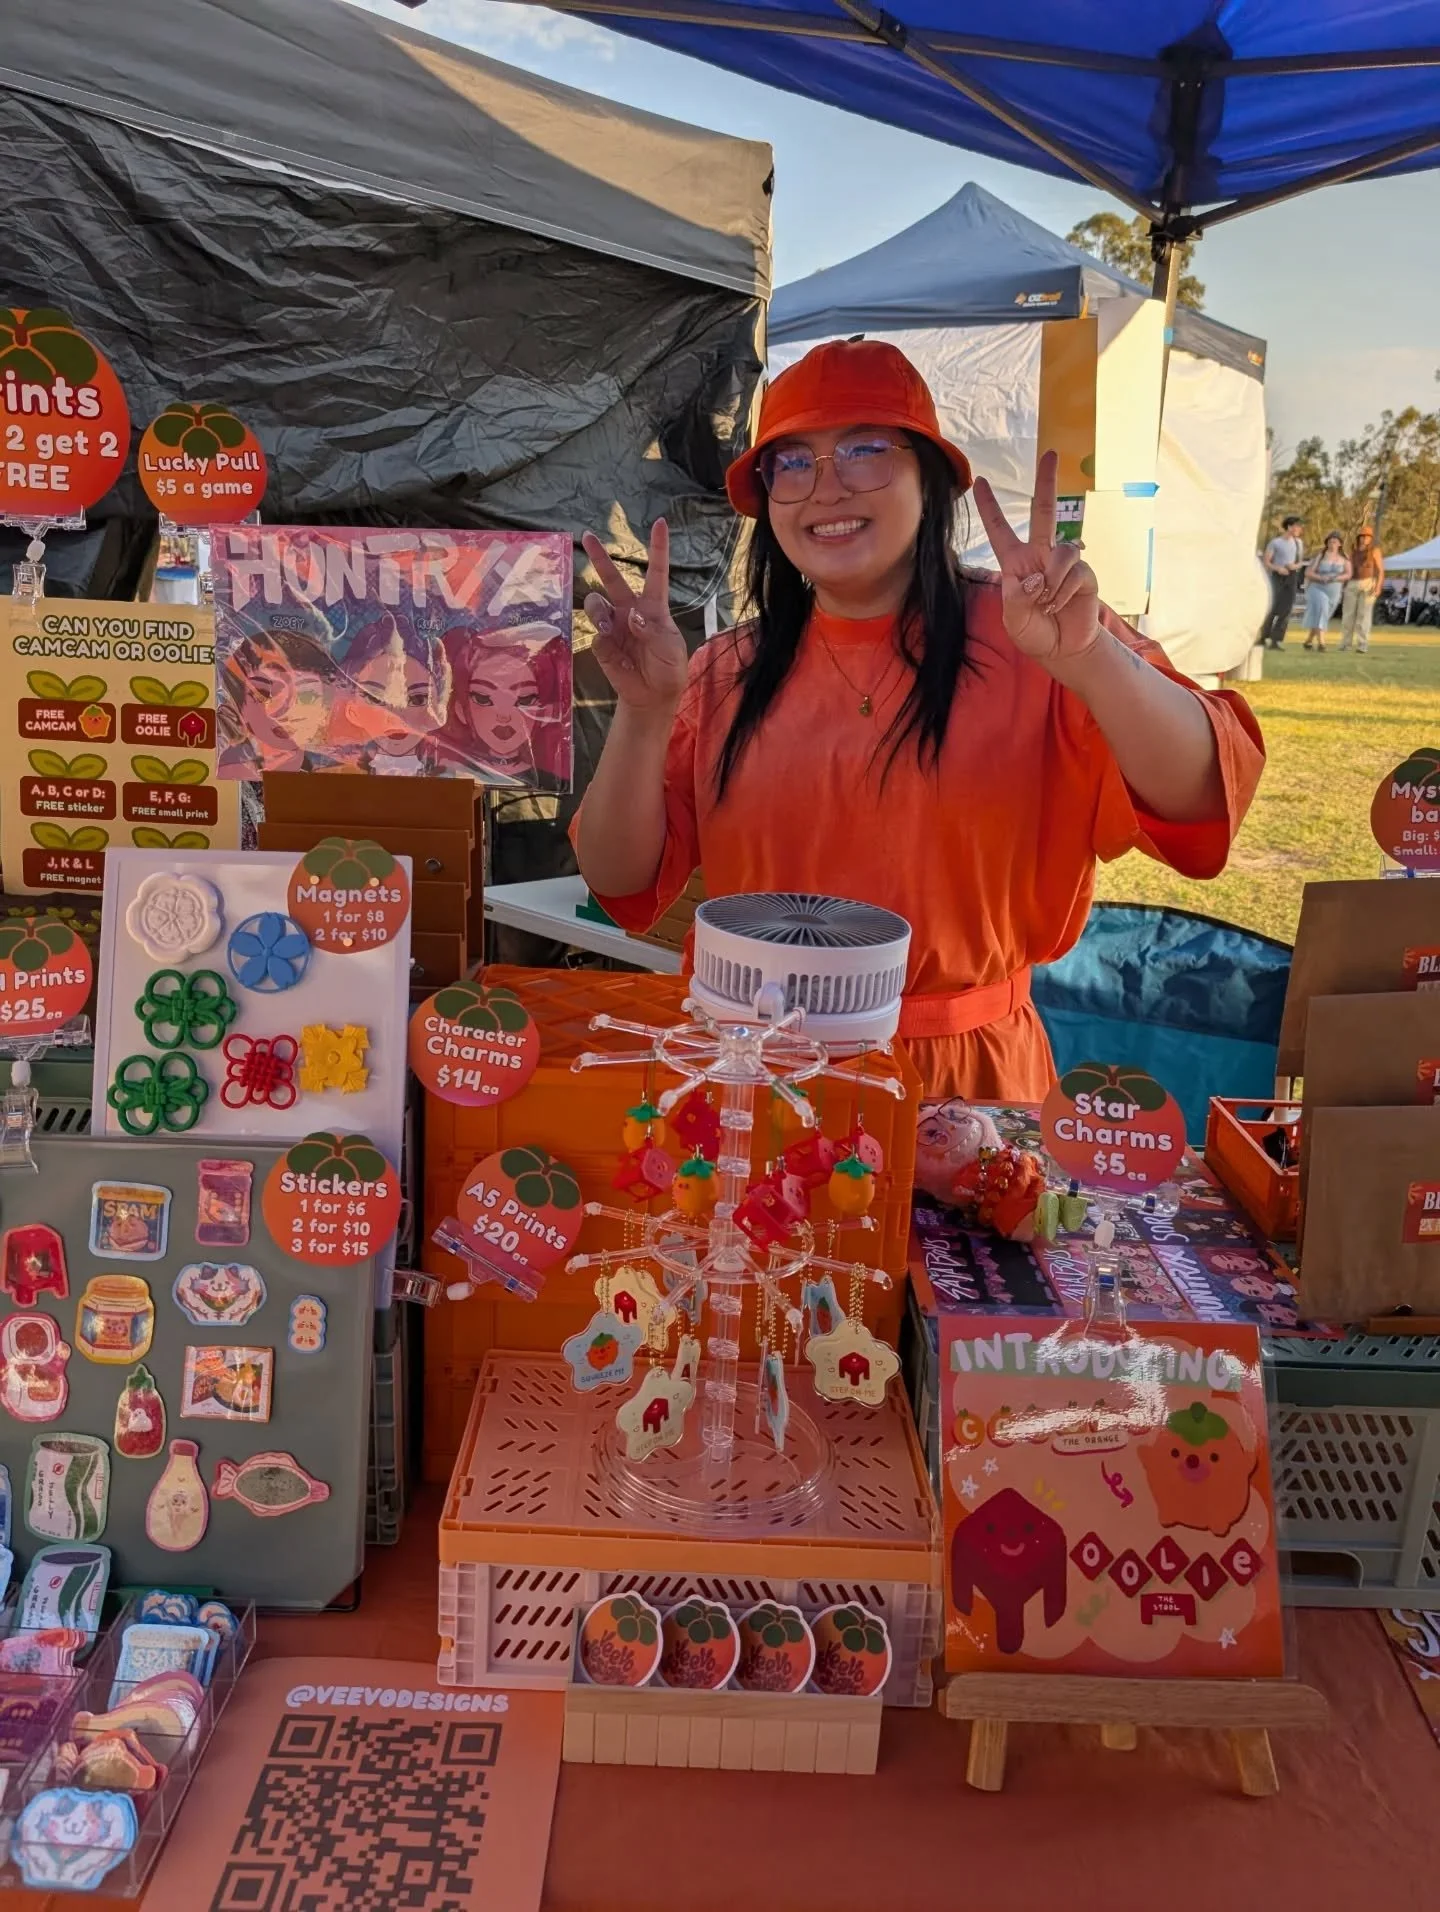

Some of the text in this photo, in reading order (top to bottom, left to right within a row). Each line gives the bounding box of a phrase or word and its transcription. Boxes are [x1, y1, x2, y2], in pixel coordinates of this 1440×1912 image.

[0, 370, 101, 418] ints
[5, 424, 119, 460] 2 get 2
[144, 452, 260, 476] Lucky Pull
[156, 479, 253, 499] $5 a game
[44, 615, 194, 641] CAN YOU FIND
[14, 637, 216, 665] CAMCAM OR OOLIE
[36, 709, 65, 719] FREE
[138, 713, 168, 724] FREE
[25, 720, 77, 732] CAMCAM
[135, 725, 171, 737] OOLIE
[31, 785, 106, 799] A, B, C or D:
[1391, 781, 1440, 804] Mys
[36, 800, 104, 814] FREE sticker
[132, 807, 209, 820] FREE small print
[61, 857, 70, 868] K
[86, 859, 94, 869] L
[40, 872, 102, 885] FREE magnet
[296, 885, 401, 907] Magnets
[323, 910, 384, 924] 1 for $8
[315, 929, 387, 942] 2 for $10
[15, 967, 86, 990] Prints
[424, 1015, 527, 1049] Character
[427, 1035, 522, 1070] Charms
[1075, 1093, 1140, 1120] Star
[1055, 1118, 1173, 1151] Charms
[280, 1171, 389, 1198] Stickers
[103, 1200, 158, 1220] SPAM
[299, 1198, 366, 1218] 1 for $6
[466, 1180, 568, 1250] A5 Prints
[292, 1218, 371, 1237] 2 for $10
[291, 1237, 369, 1257] 3 for $15
[954, 1333, 1232, 1389] INTRODUING
[1062, 1433, 1120, 1446] THE ORANGE
[286, 1685, 509, 1713] @VEEVODESIGNS
